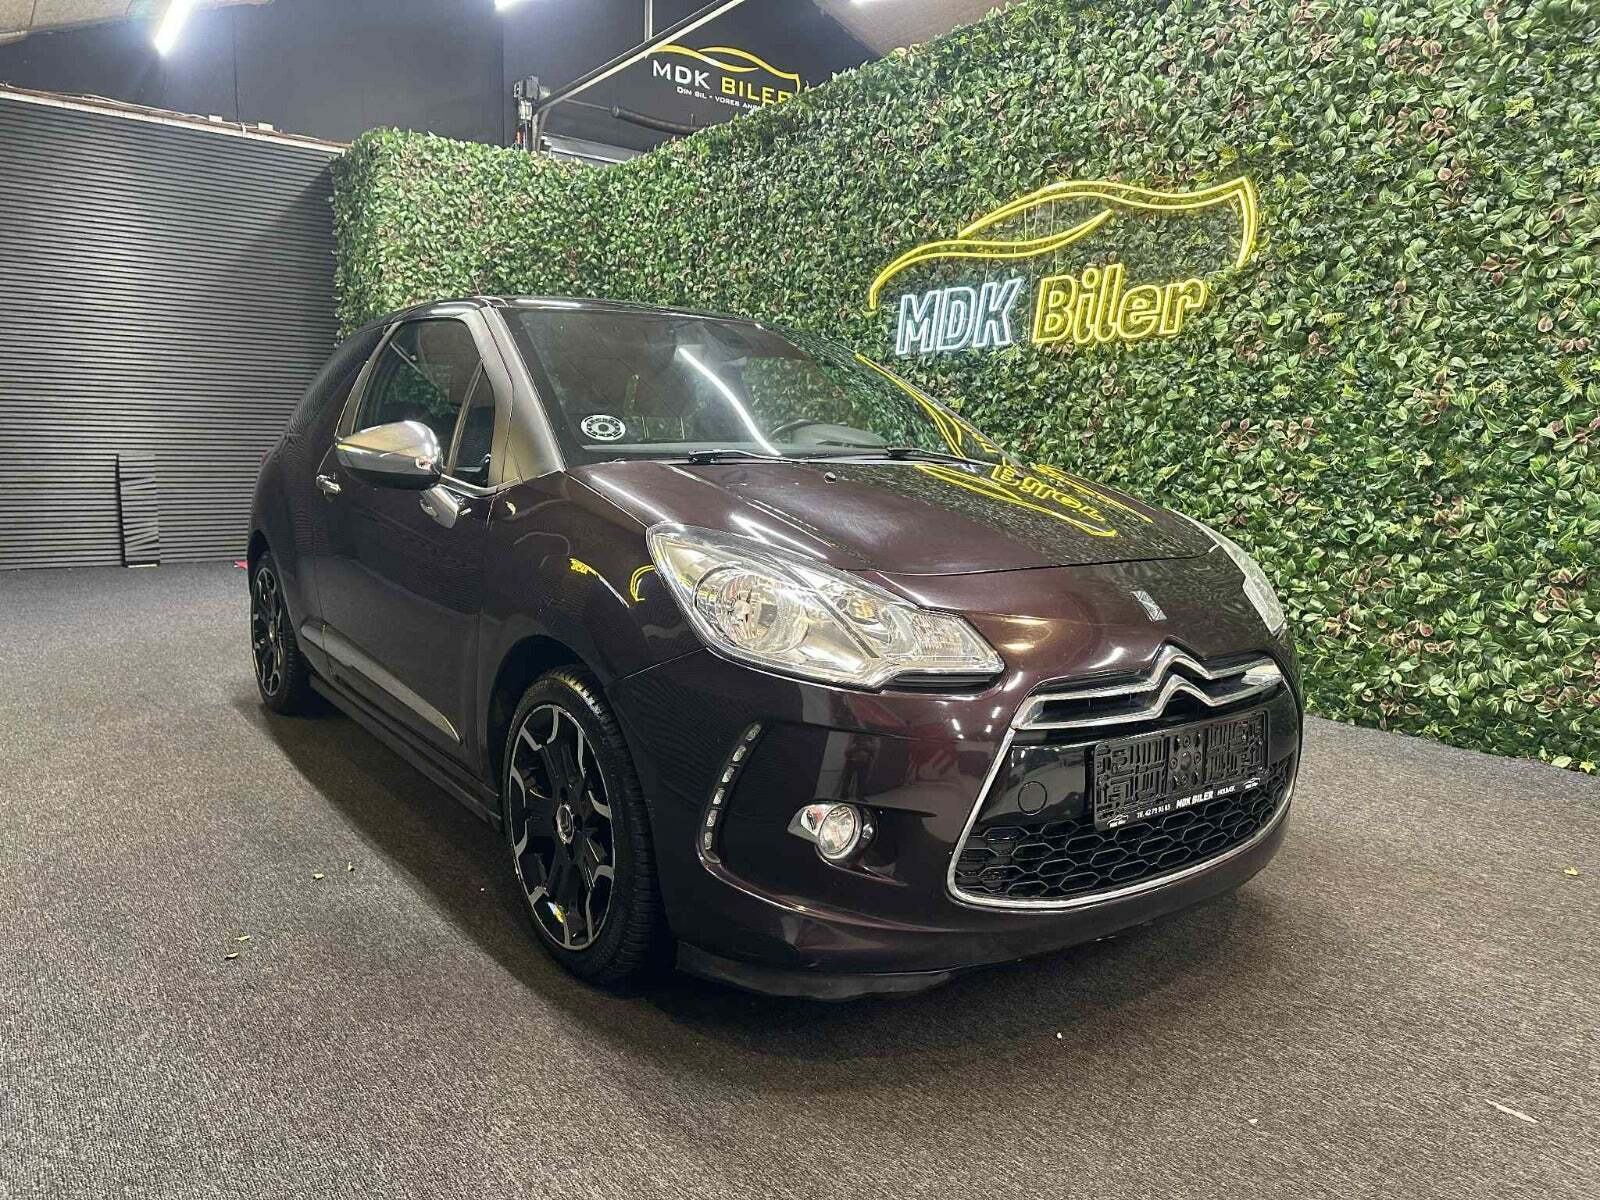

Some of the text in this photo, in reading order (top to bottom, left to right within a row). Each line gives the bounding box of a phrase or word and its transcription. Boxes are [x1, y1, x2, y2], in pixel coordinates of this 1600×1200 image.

[652, 59, 793, 105] MDK BILER
[714, 95, 741, 108] VORES
[895, 262, 1208, 356] MDK Biler
[1191, 790, 1214, 805] BILER
